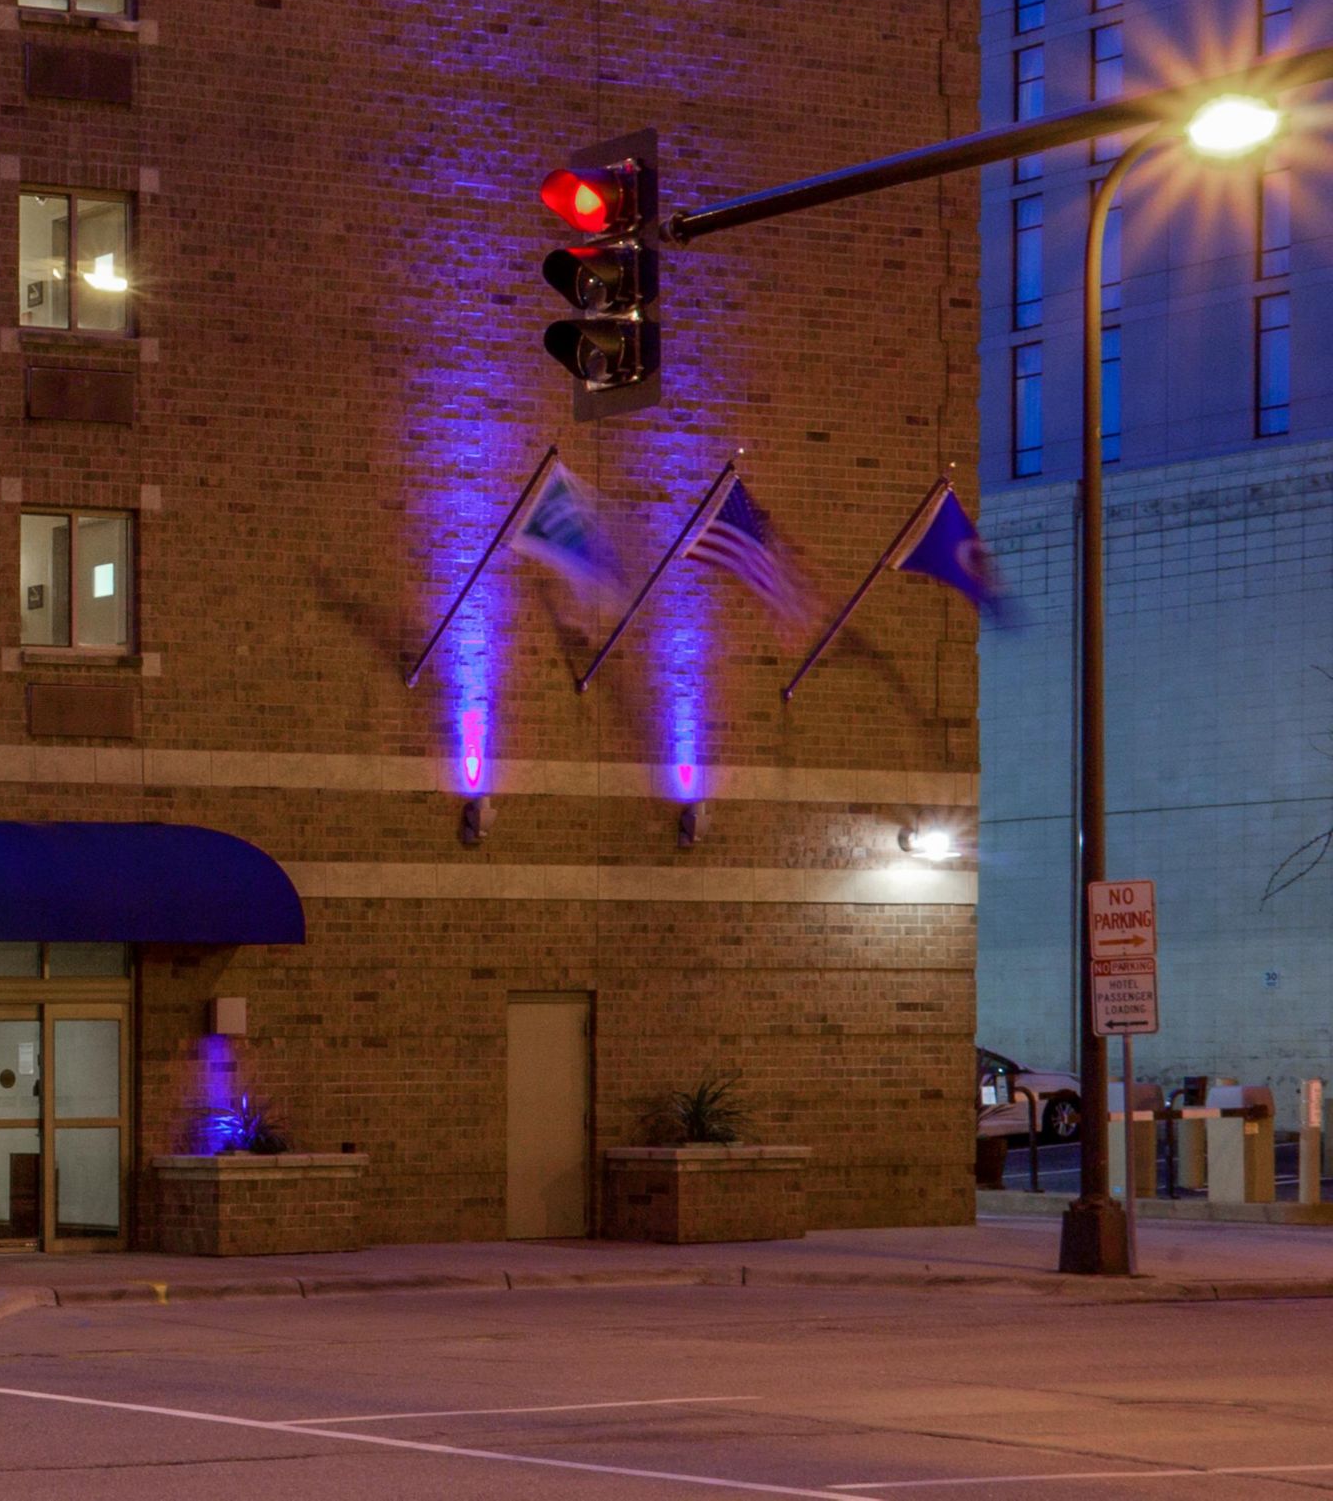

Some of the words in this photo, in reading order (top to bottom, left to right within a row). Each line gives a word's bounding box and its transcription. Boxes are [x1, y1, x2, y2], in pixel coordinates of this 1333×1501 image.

[1109, 887, 1134, 906] NO
[1093, 910, 1151, 931] PARKING
[1094, 962, 1110, 974] NO
[1113, 961, 1153, 972] PARKING
[1108, 979, 1139, 990] HOTEL
[1097, 991, 1153, 1003] PASSENGER
[1105, 1004, 1146, 1016] LOADING
